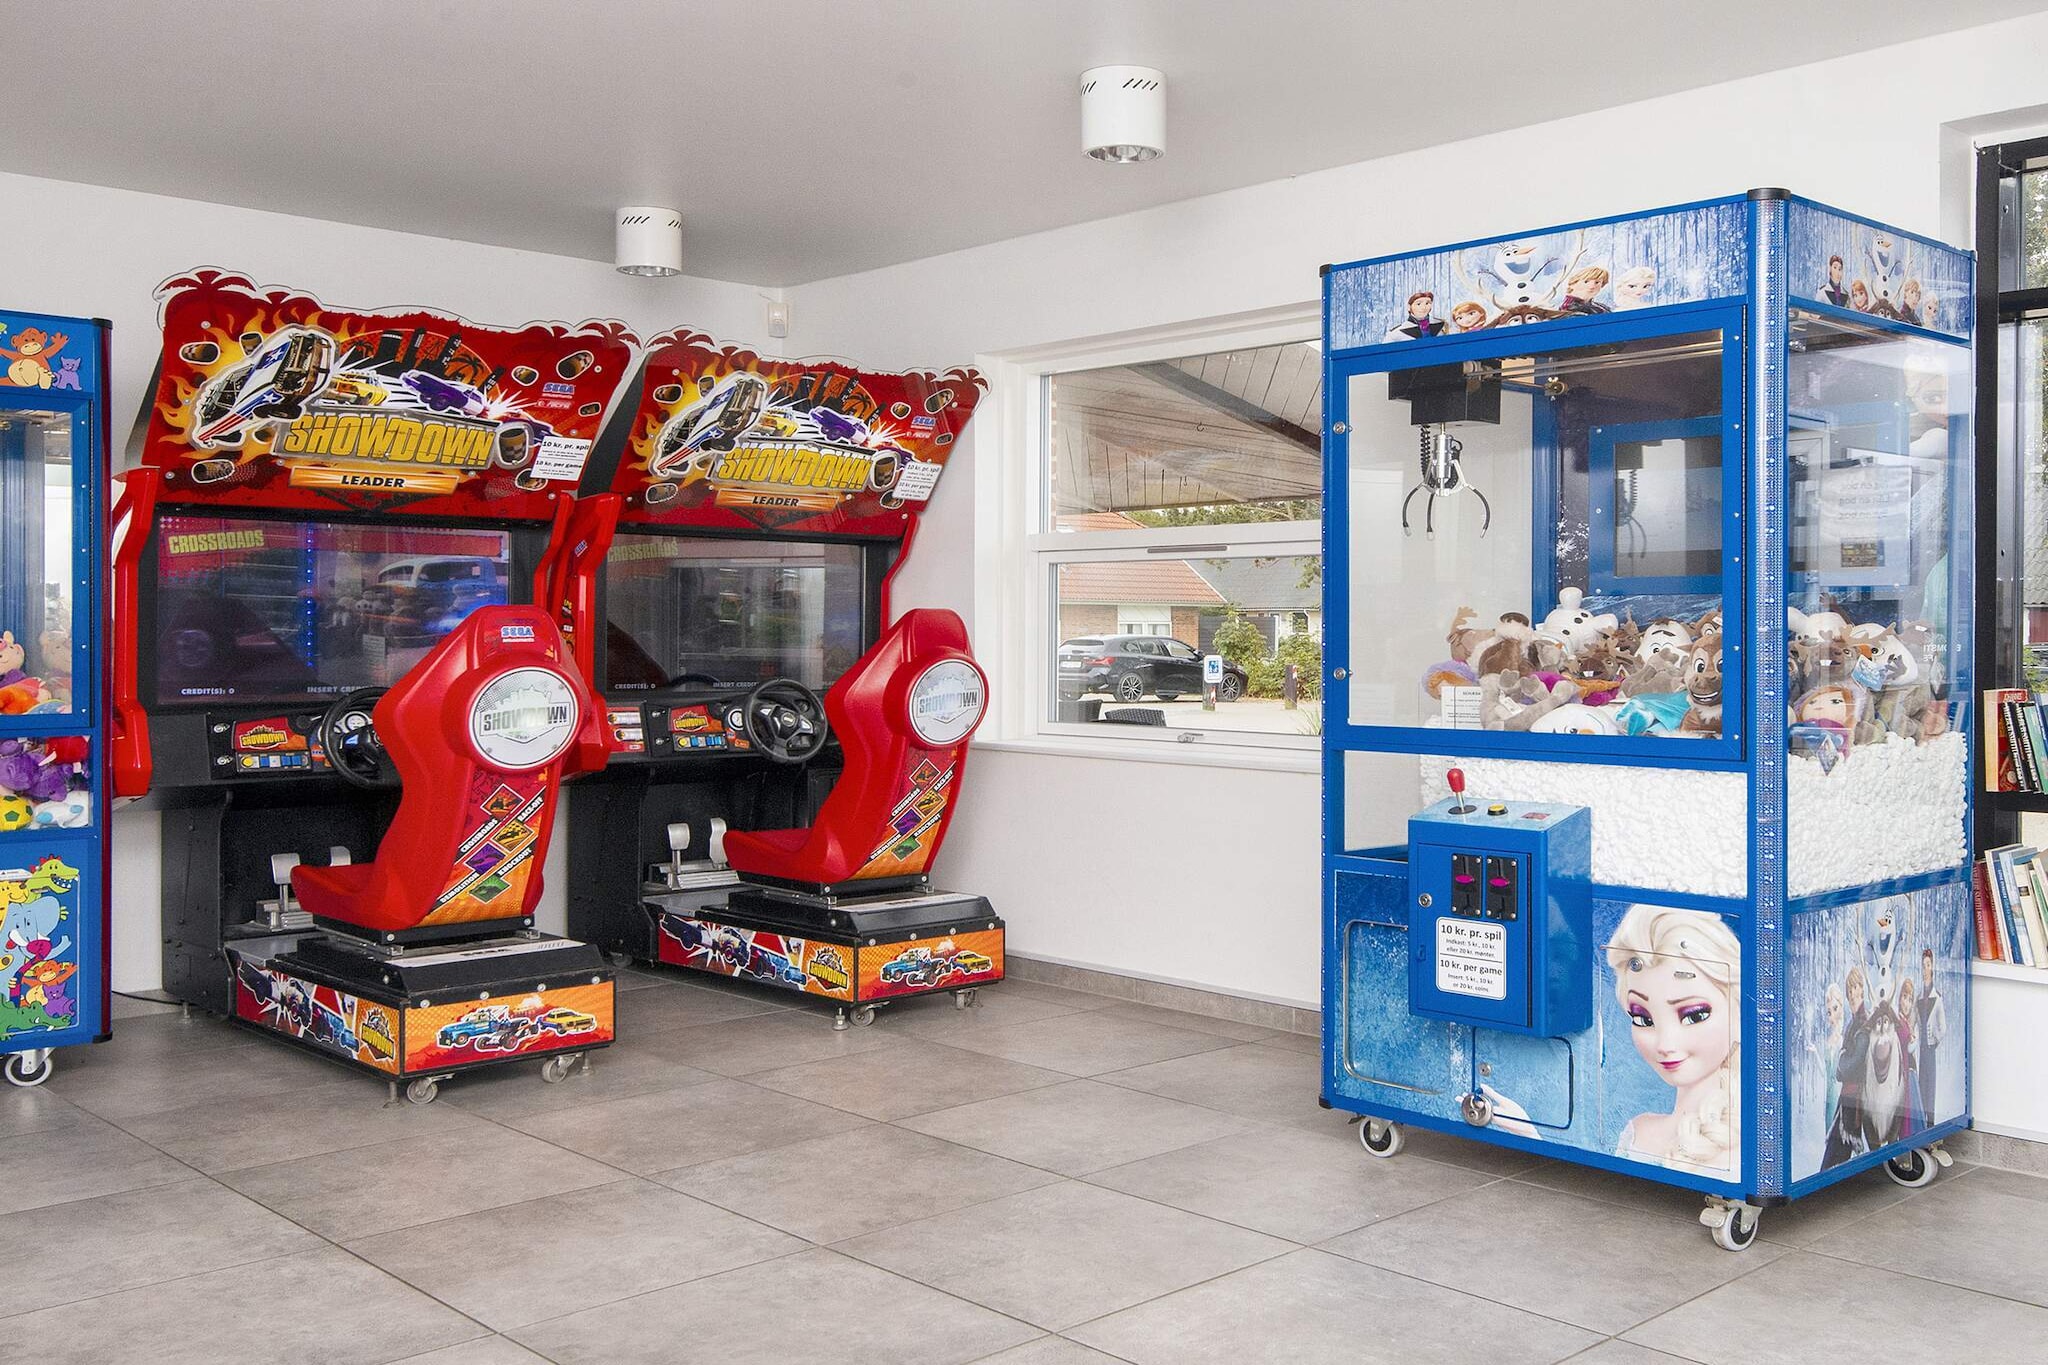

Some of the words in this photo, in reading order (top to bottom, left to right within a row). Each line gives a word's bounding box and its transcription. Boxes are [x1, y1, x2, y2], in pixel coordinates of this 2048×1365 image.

[543, 382, 575, 395] SEGA
[284, 414, 496, 466] SHOWDOWN
[576, 443, 590, 451] spil
[718, 447, 872, 489] SHOWDOWN
[341, 475, 406, 489] LEADER
[752, 495, 800, 507] LEADER
[168, 530, 264, 554] CROSSROADS
[607, 540, 678, 563] CROSSROADS
[501, 626, 535, 637] SEGA
[241, 731, 286, 746] SHOWDOWN
[518, 797, 543, 821] RACE-OFF
[460, 819, 498, 853] CROSSROADS
[497, 848, 532, 875] KNOCKOUT
[440, 873, 479, 903] DEMOLITION
[1441, 924, 1452, 934] 10
[1455, 926, 1466, 936] kr.
[1470, 930, 1482, 938] pr.
[1484, 931, 1502, 941] spil
[1440, 960, 1450, 968] 10
[1452, 960, 1462, 970] kr.
[1464, 964, 1477, 972] per
[1479, 966, 1502, 976] game
